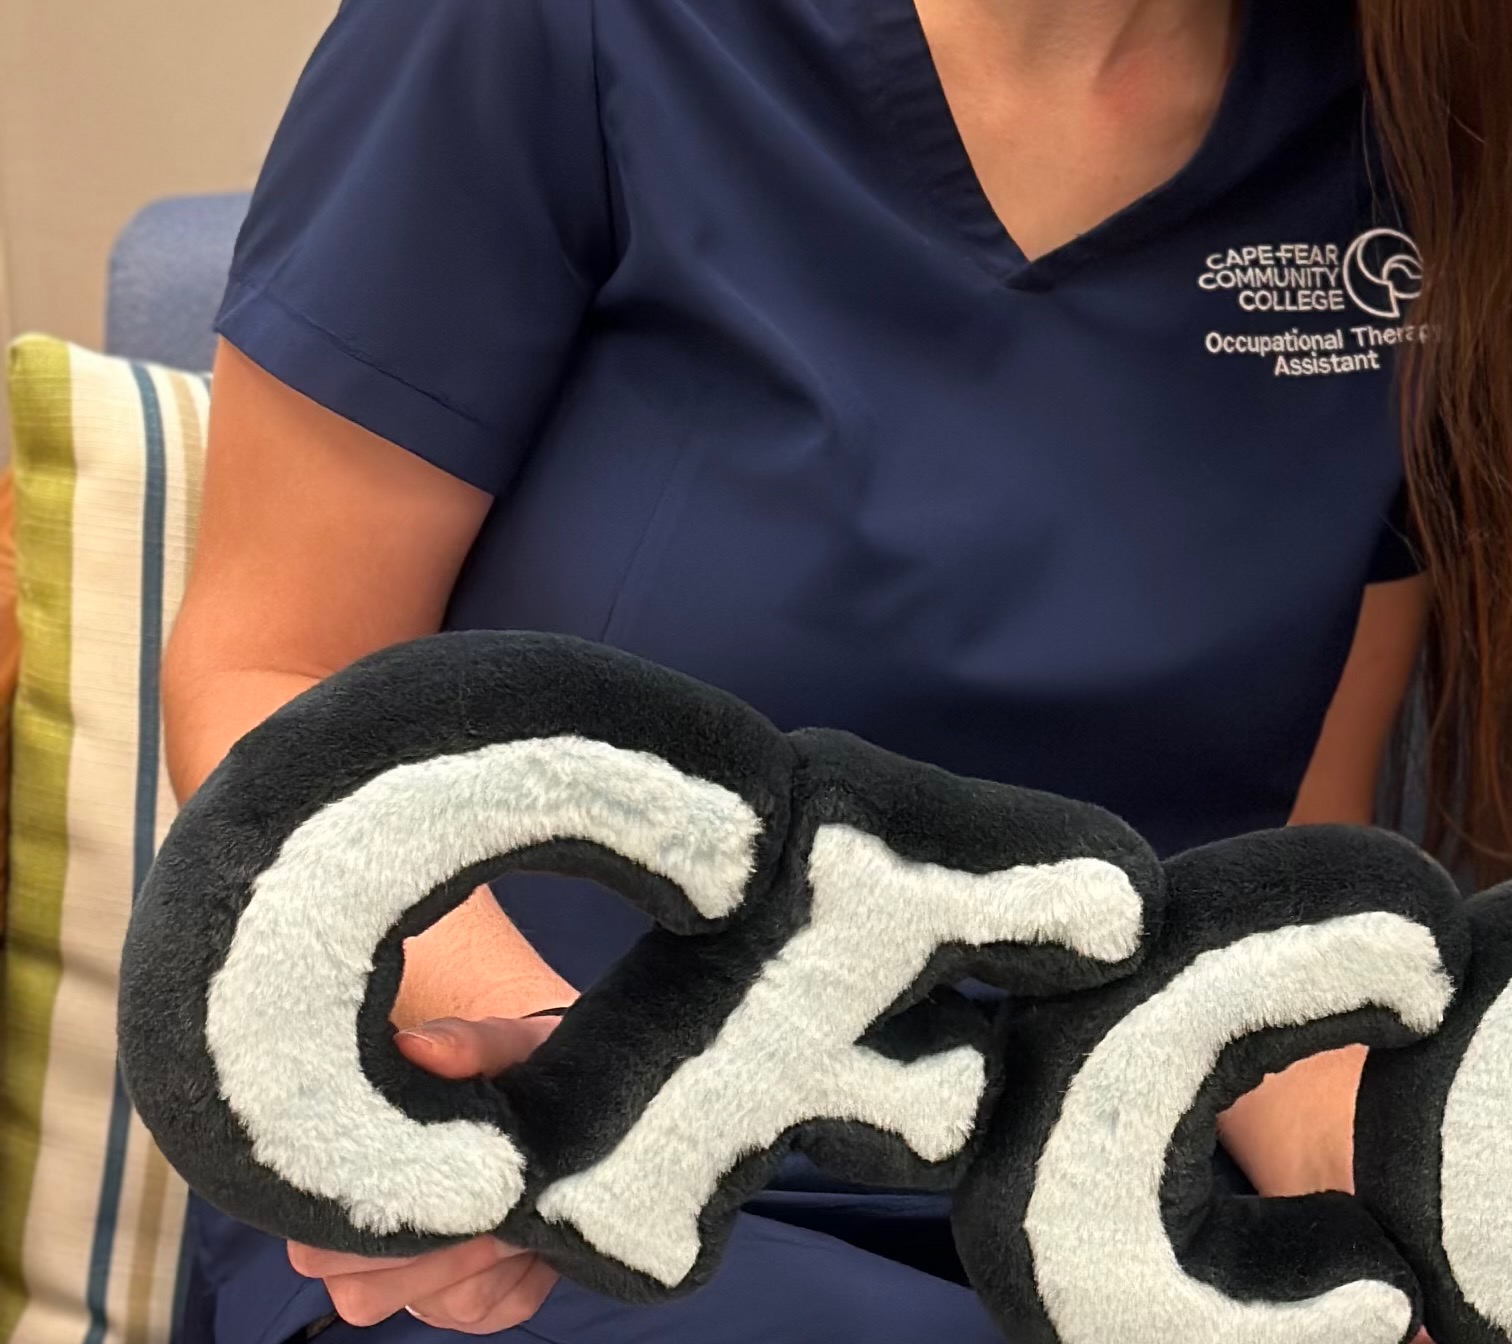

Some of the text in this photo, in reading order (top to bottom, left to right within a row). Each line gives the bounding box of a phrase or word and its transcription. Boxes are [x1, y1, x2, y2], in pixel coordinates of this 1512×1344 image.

[1198, 267, 1340, 290] COMMUNITY
[1239, 290, 1345, 311] COLLEGE
[1205, 329, 1344, 356] Occupational
[1274, 350, 1380, 376] Assistant
